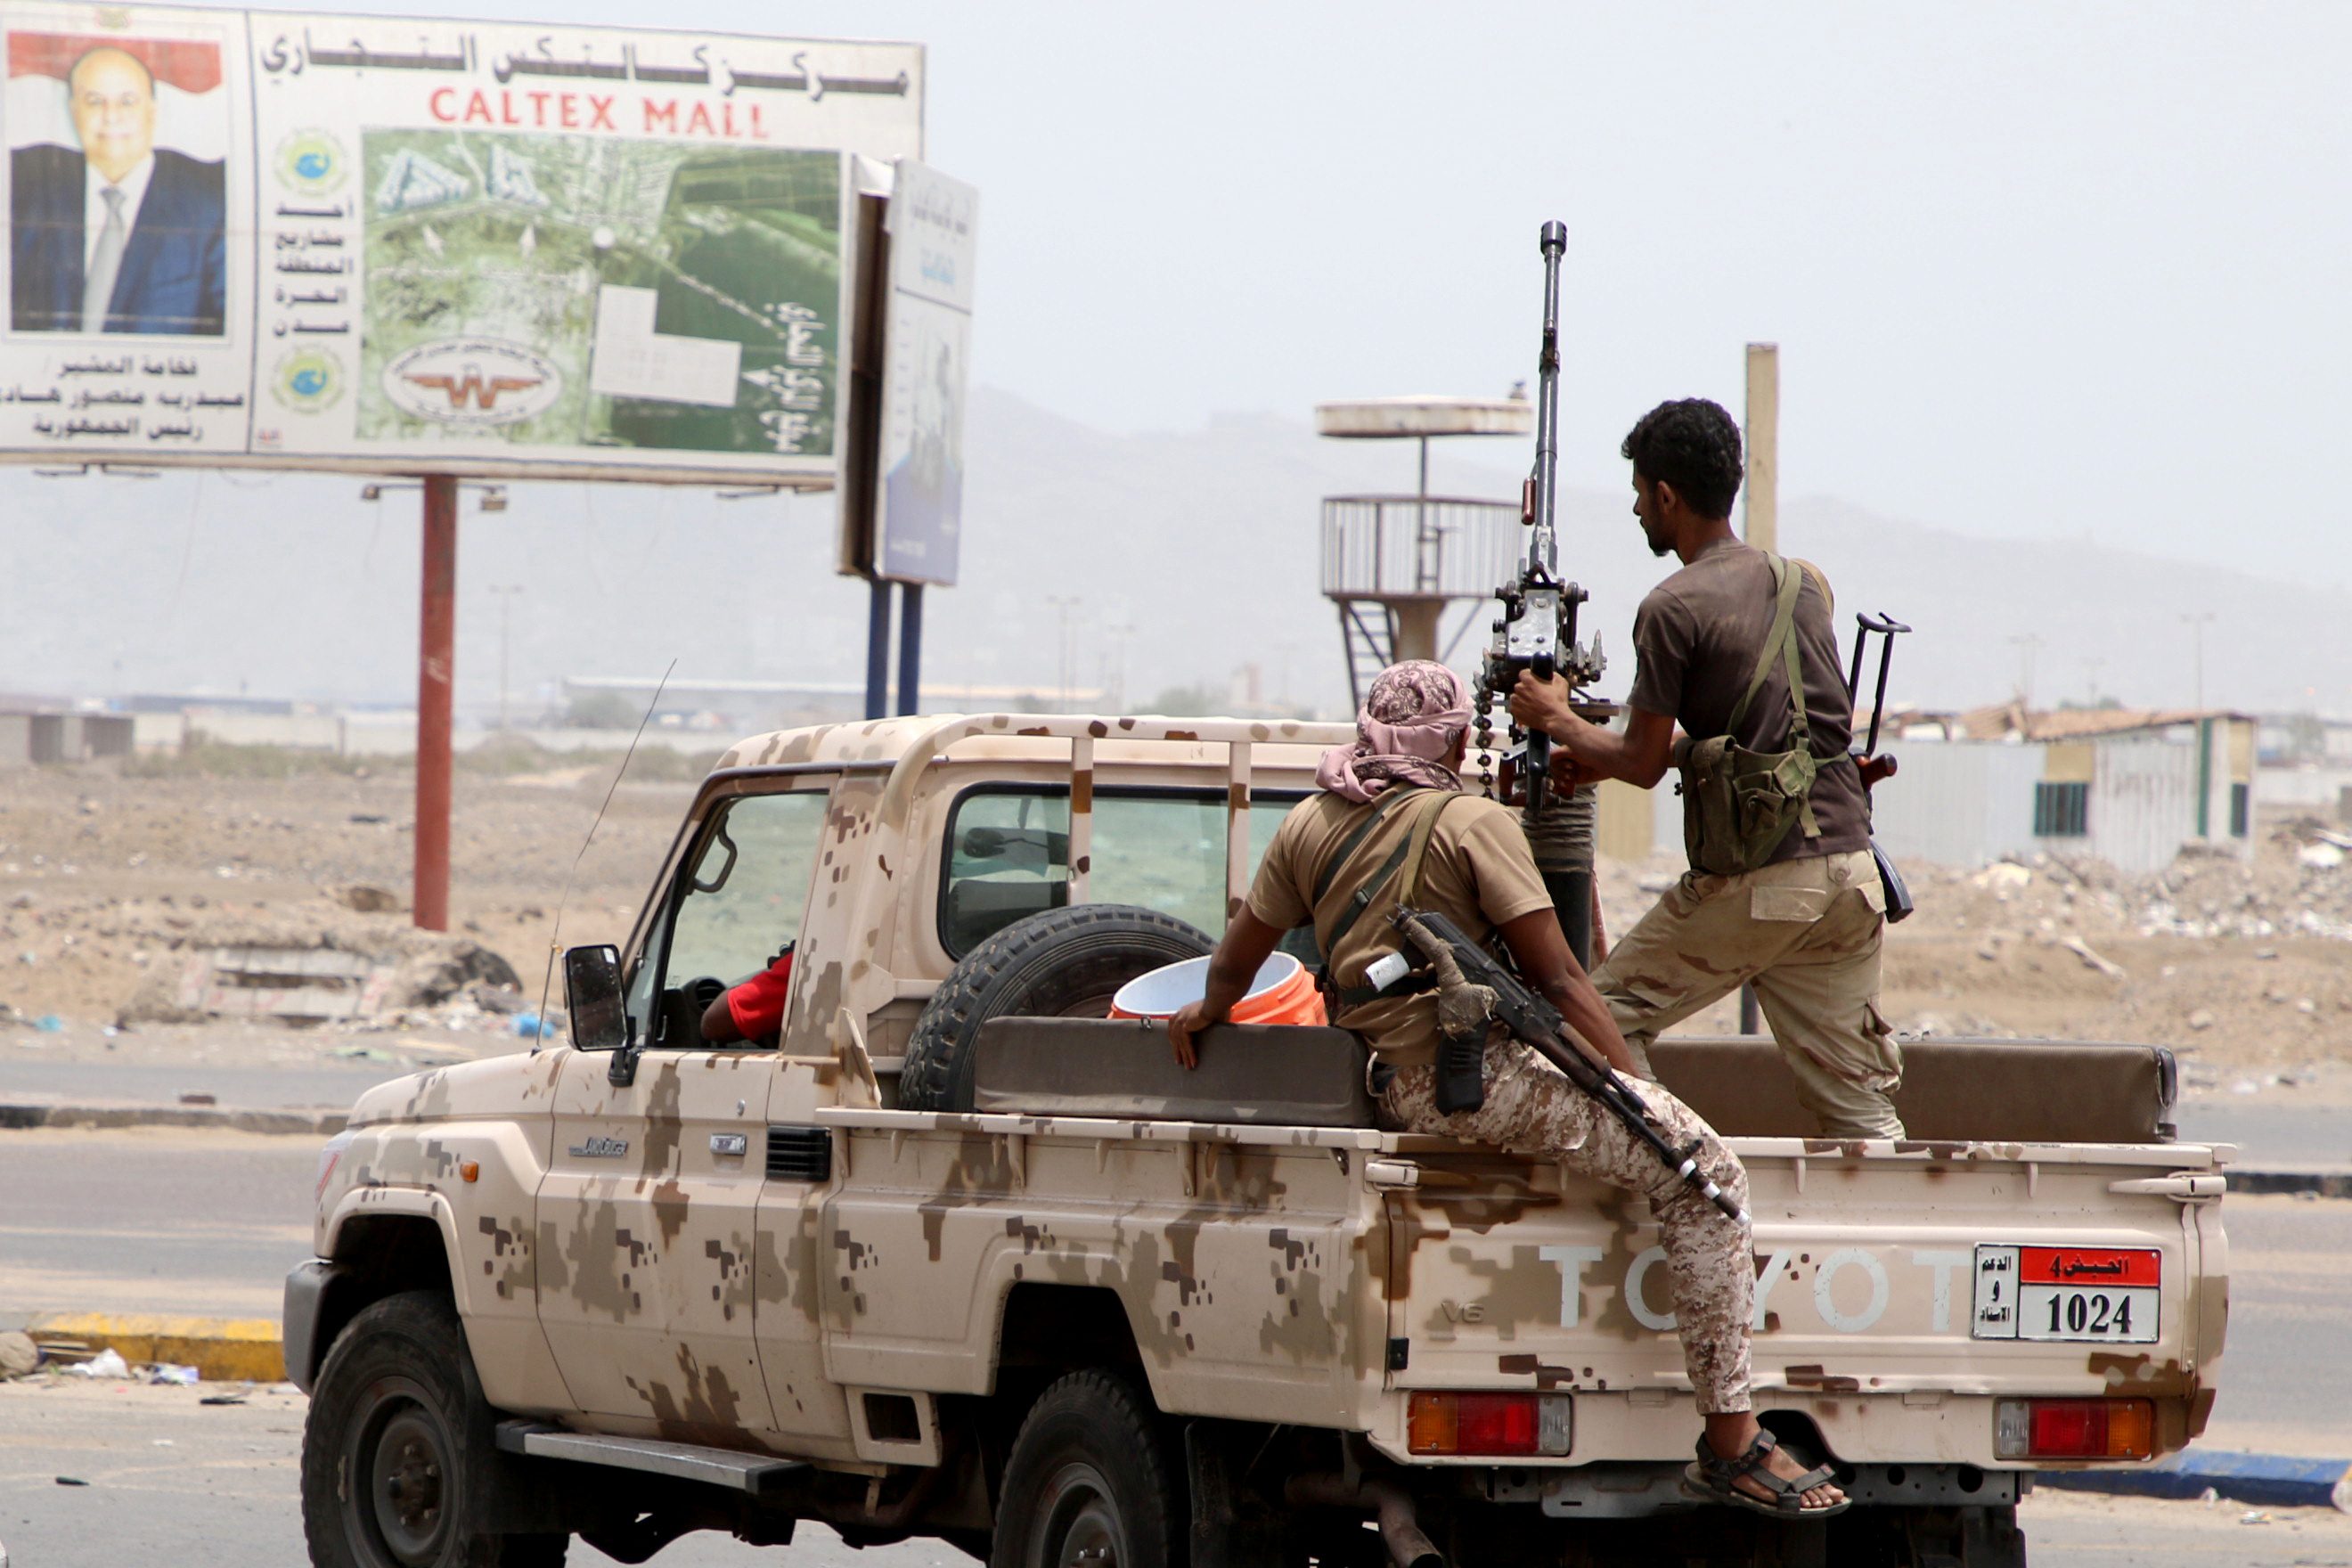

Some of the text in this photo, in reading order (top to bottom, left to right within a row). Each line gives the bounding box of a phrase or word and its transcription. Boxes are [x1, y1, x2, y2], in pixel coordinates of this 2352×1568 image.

[261, 28, 909, 102] مركز كالتكس التجاري
[429, 86, 617, 131] CALTEX
[275, 255, 354, 274] المنطقة
[274, 285, 347, 308] الحرة
[764, 302, 828, 366] التجاري
[58, 355, 197, 379] فخامة المشير
[69, 388, 145, 410] منصور
[149, 415, 202, 441] رئيس
[1982, 1255, 2011, 1278] الدعم
[2050, 1254, 2129, 1278] الجيش 4
[1539, 1246, 1972, 1332] TOYOT
[1441, 1302, 1484, 1324] V6
[2047, 1293, 2132, 1333] 1024
